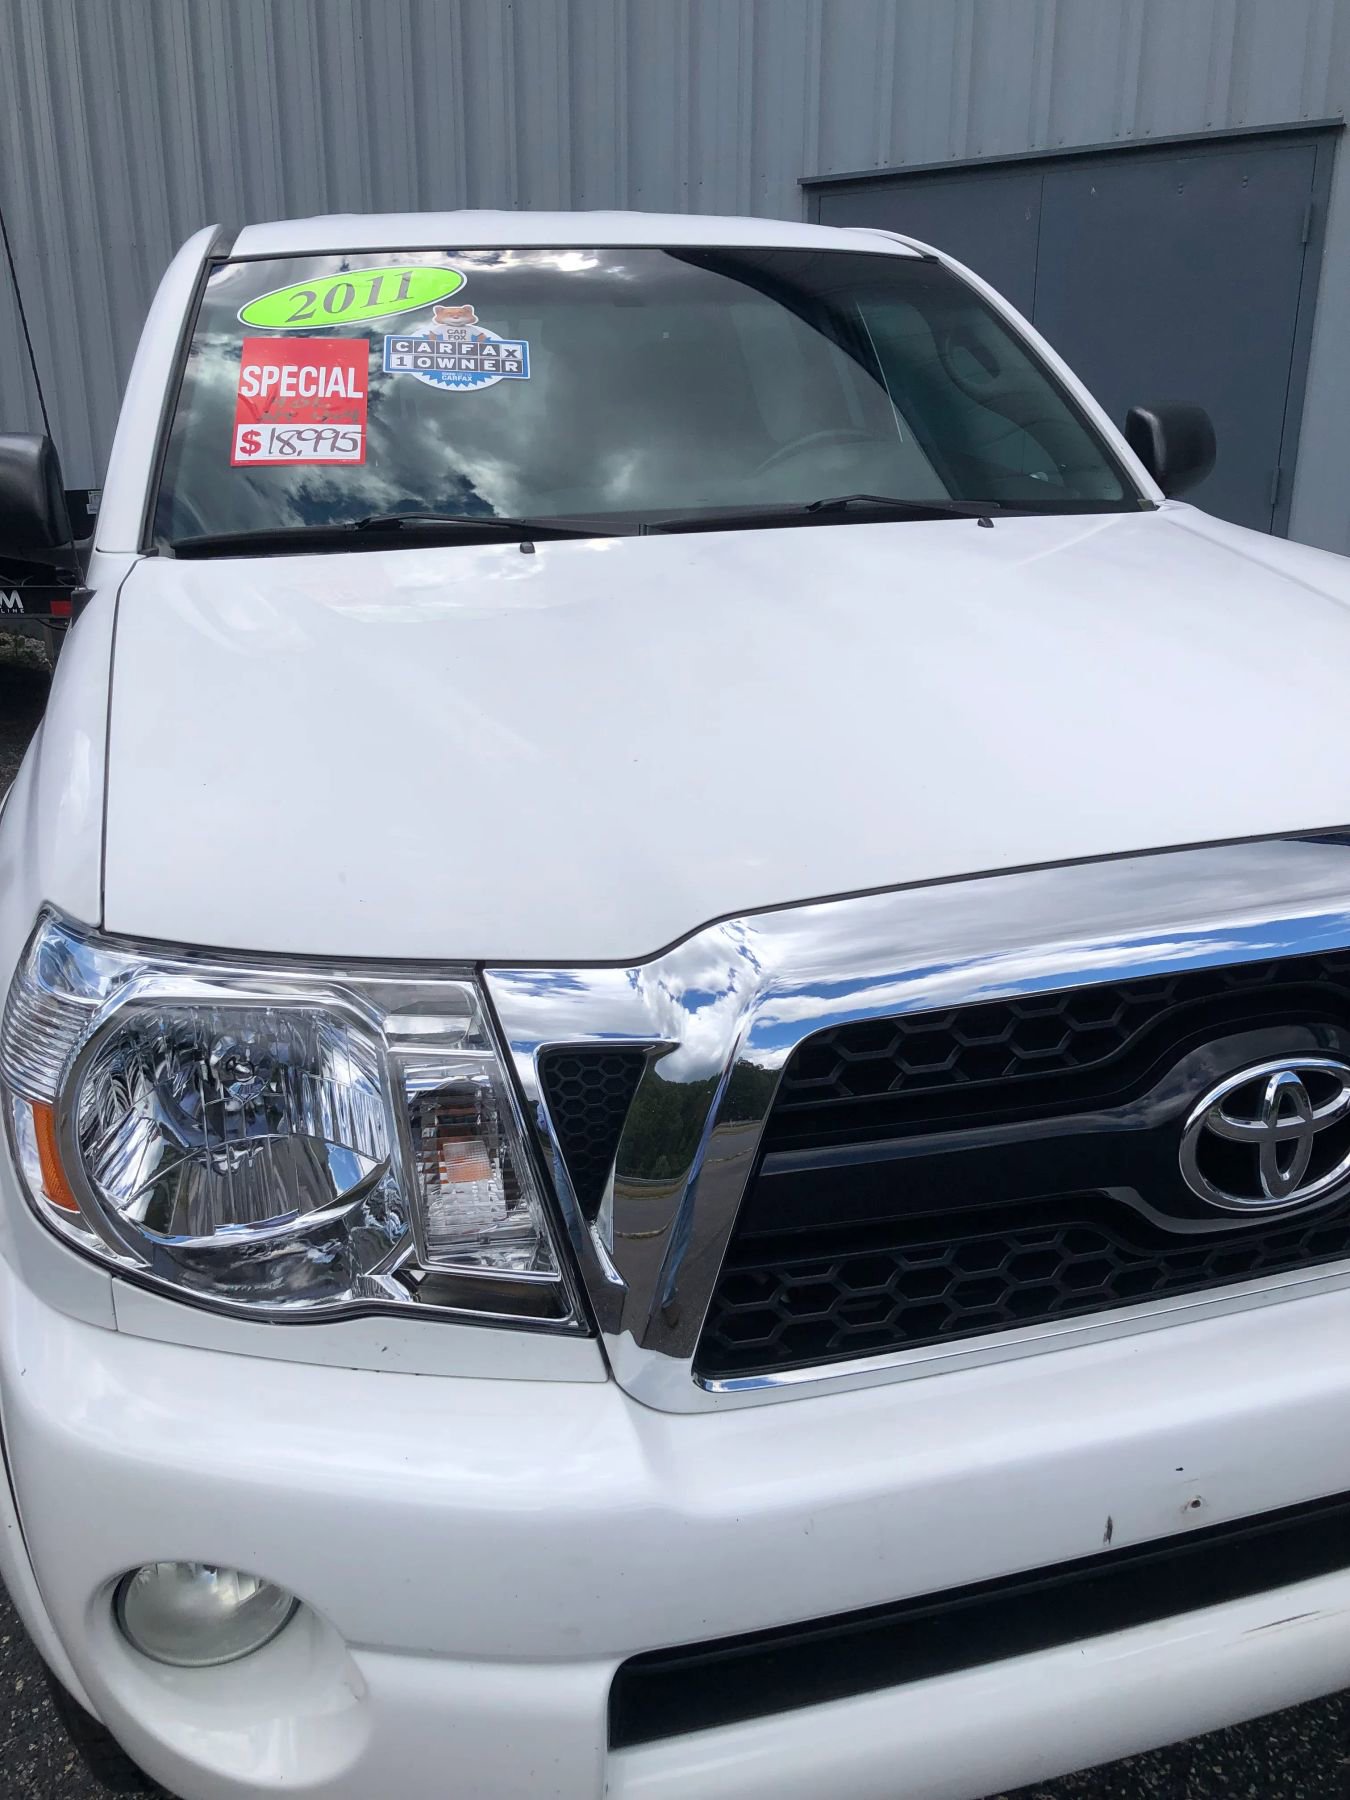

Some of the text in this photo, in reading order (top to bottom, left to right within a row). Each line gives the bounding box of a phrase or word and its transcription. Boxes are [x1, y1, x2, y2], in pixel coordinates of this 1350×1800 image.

[285, 271, 415, 323] 2011
[395, 342, 519, 358] CARFAX
[240, 365, 364, 398] SPECIAL
